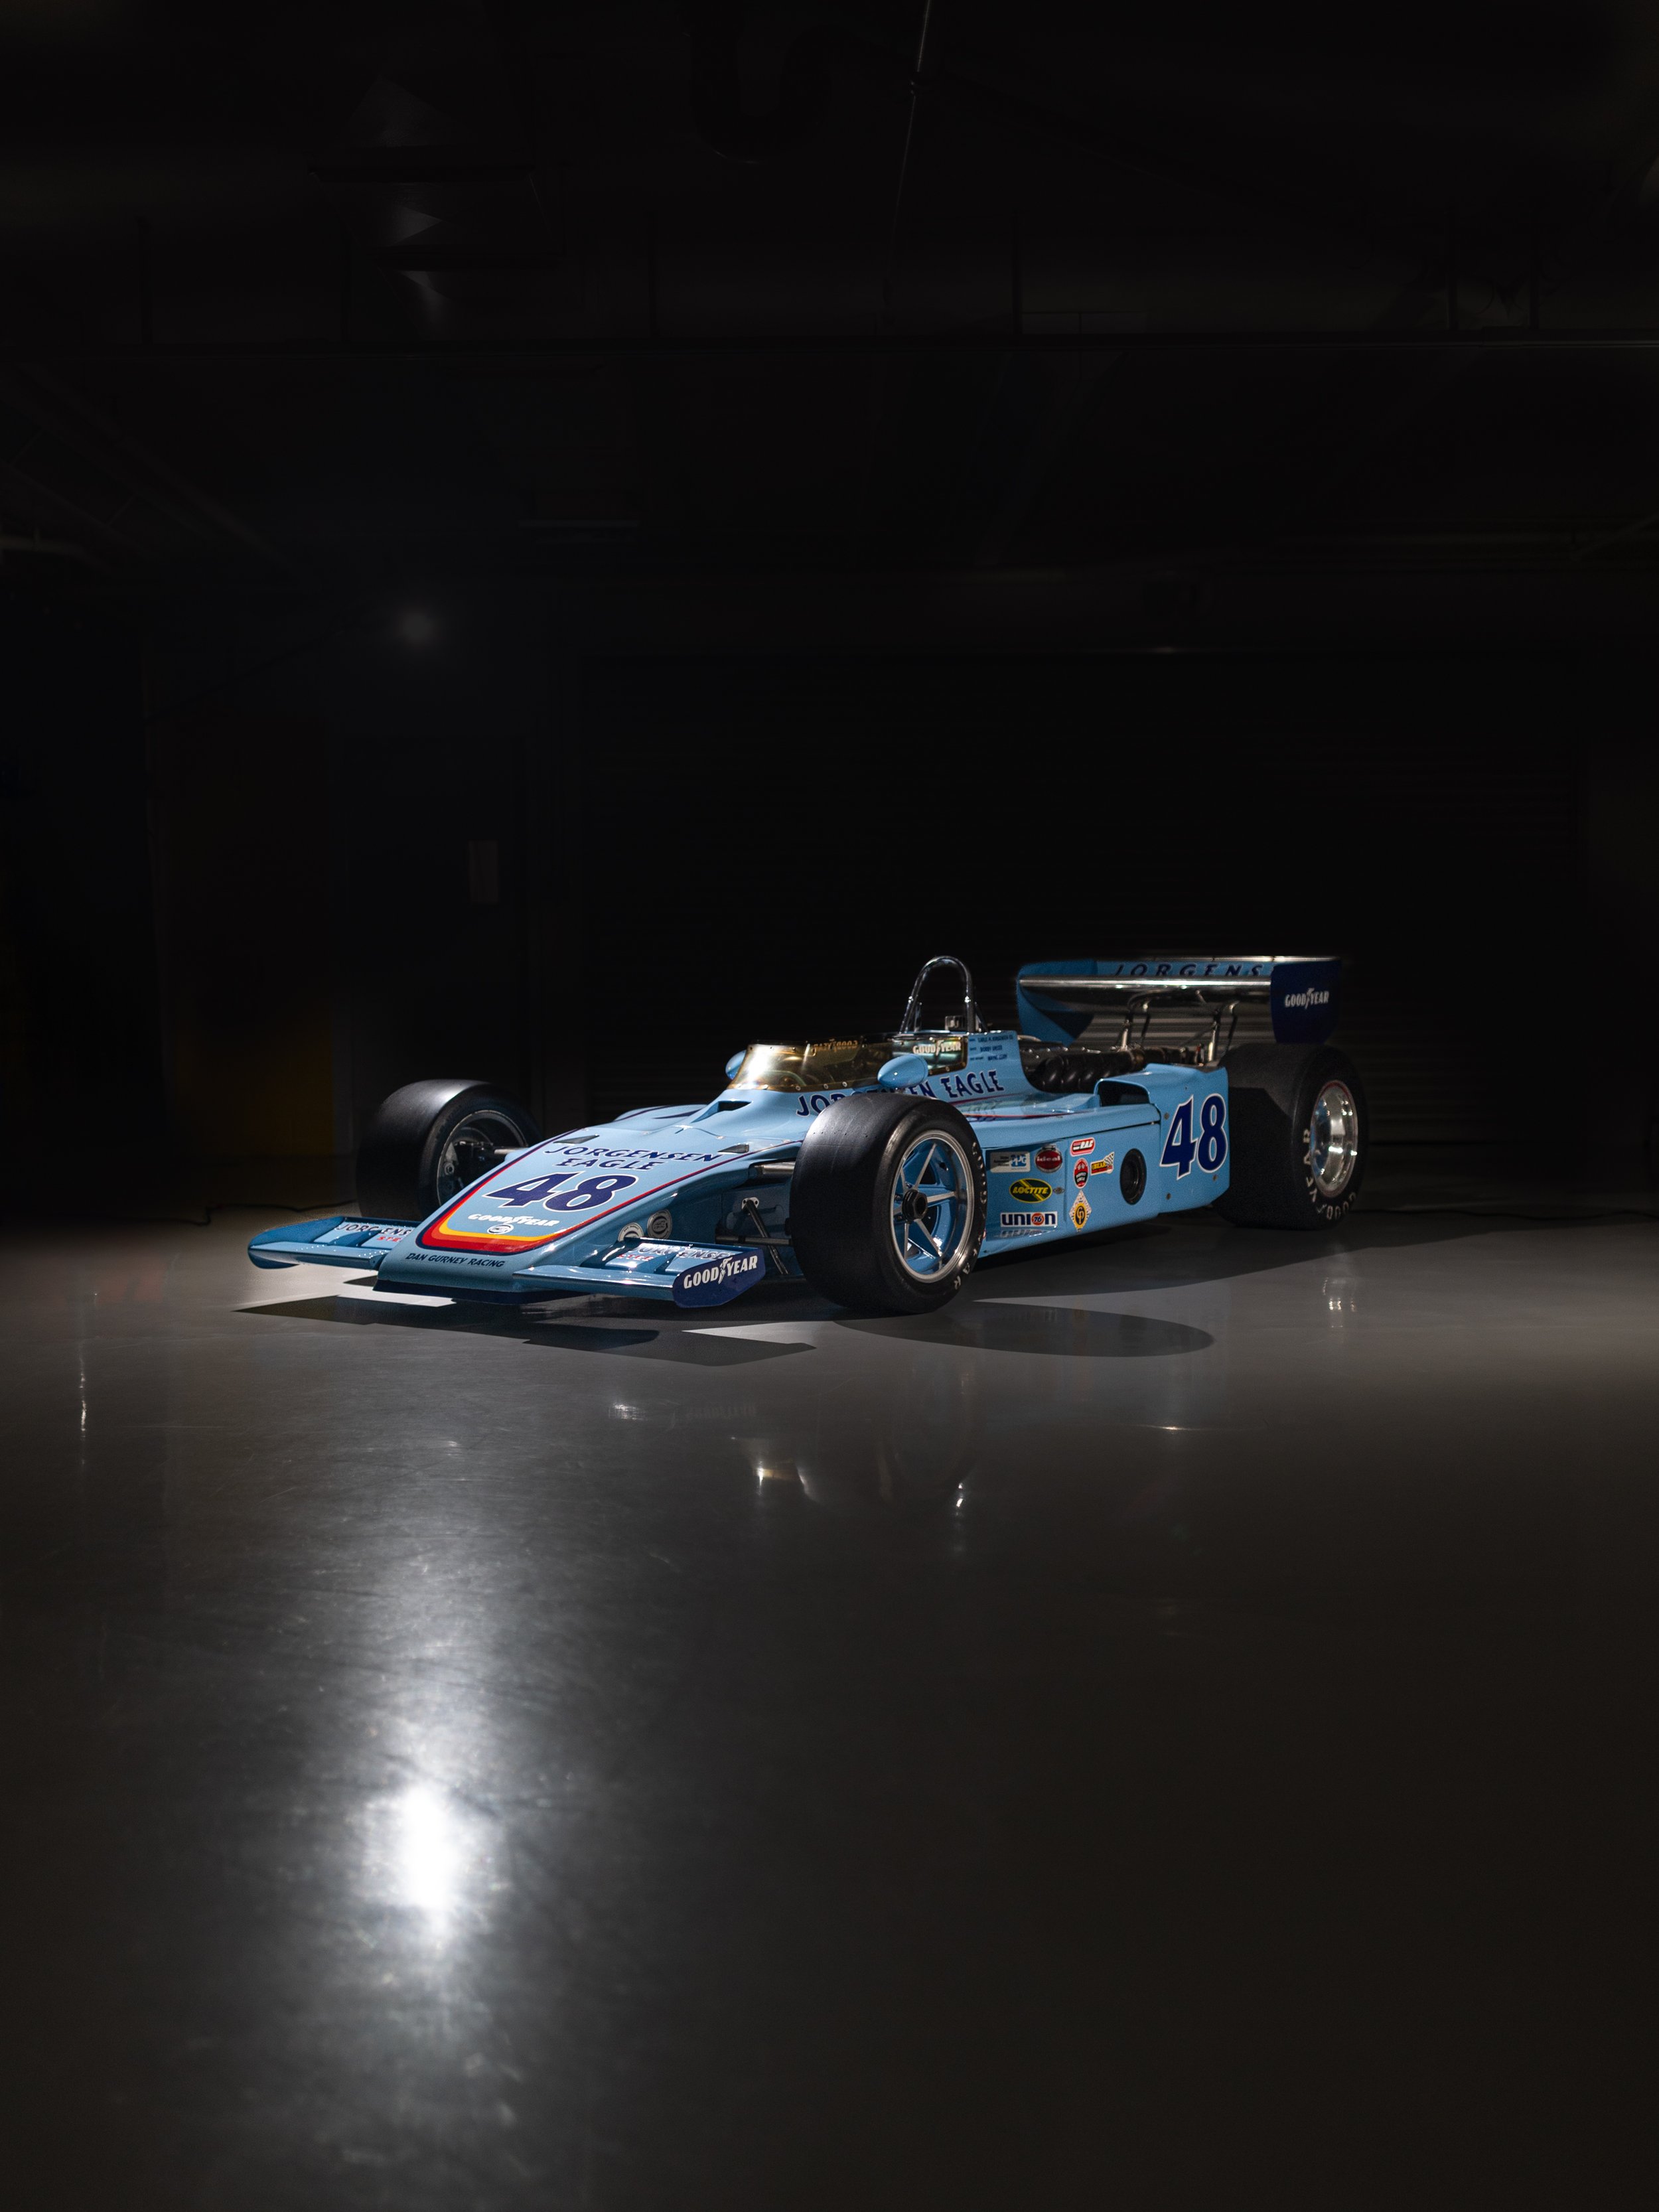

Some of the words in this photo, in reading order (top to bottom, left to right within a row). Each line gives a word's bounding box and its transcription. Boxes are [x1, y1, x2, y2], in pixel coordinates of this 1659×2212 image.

[1285, 988, 1329, 1009] GOODYEAR
[912, 1040, 962, 1056] GOODYEAR
[940, 1069, 1004, 1098] EAGLE
[1159, 1093, 1228, 1180] 48
[544, 1145, 722, 1163] JORGENSEN
[555, 1157, 664, 1171] EAGLE
[482, 1171, 638, 1212] 48
[467, 1213, 560, 1226] GOODYEAR
[405, 1252, 427, 1262] DAN
[428, 1254, 466, 1264] GURNEY
[467, 1258, 505, 1268] RACING
[683, 1255, 758, 1290] GOODYEAR
